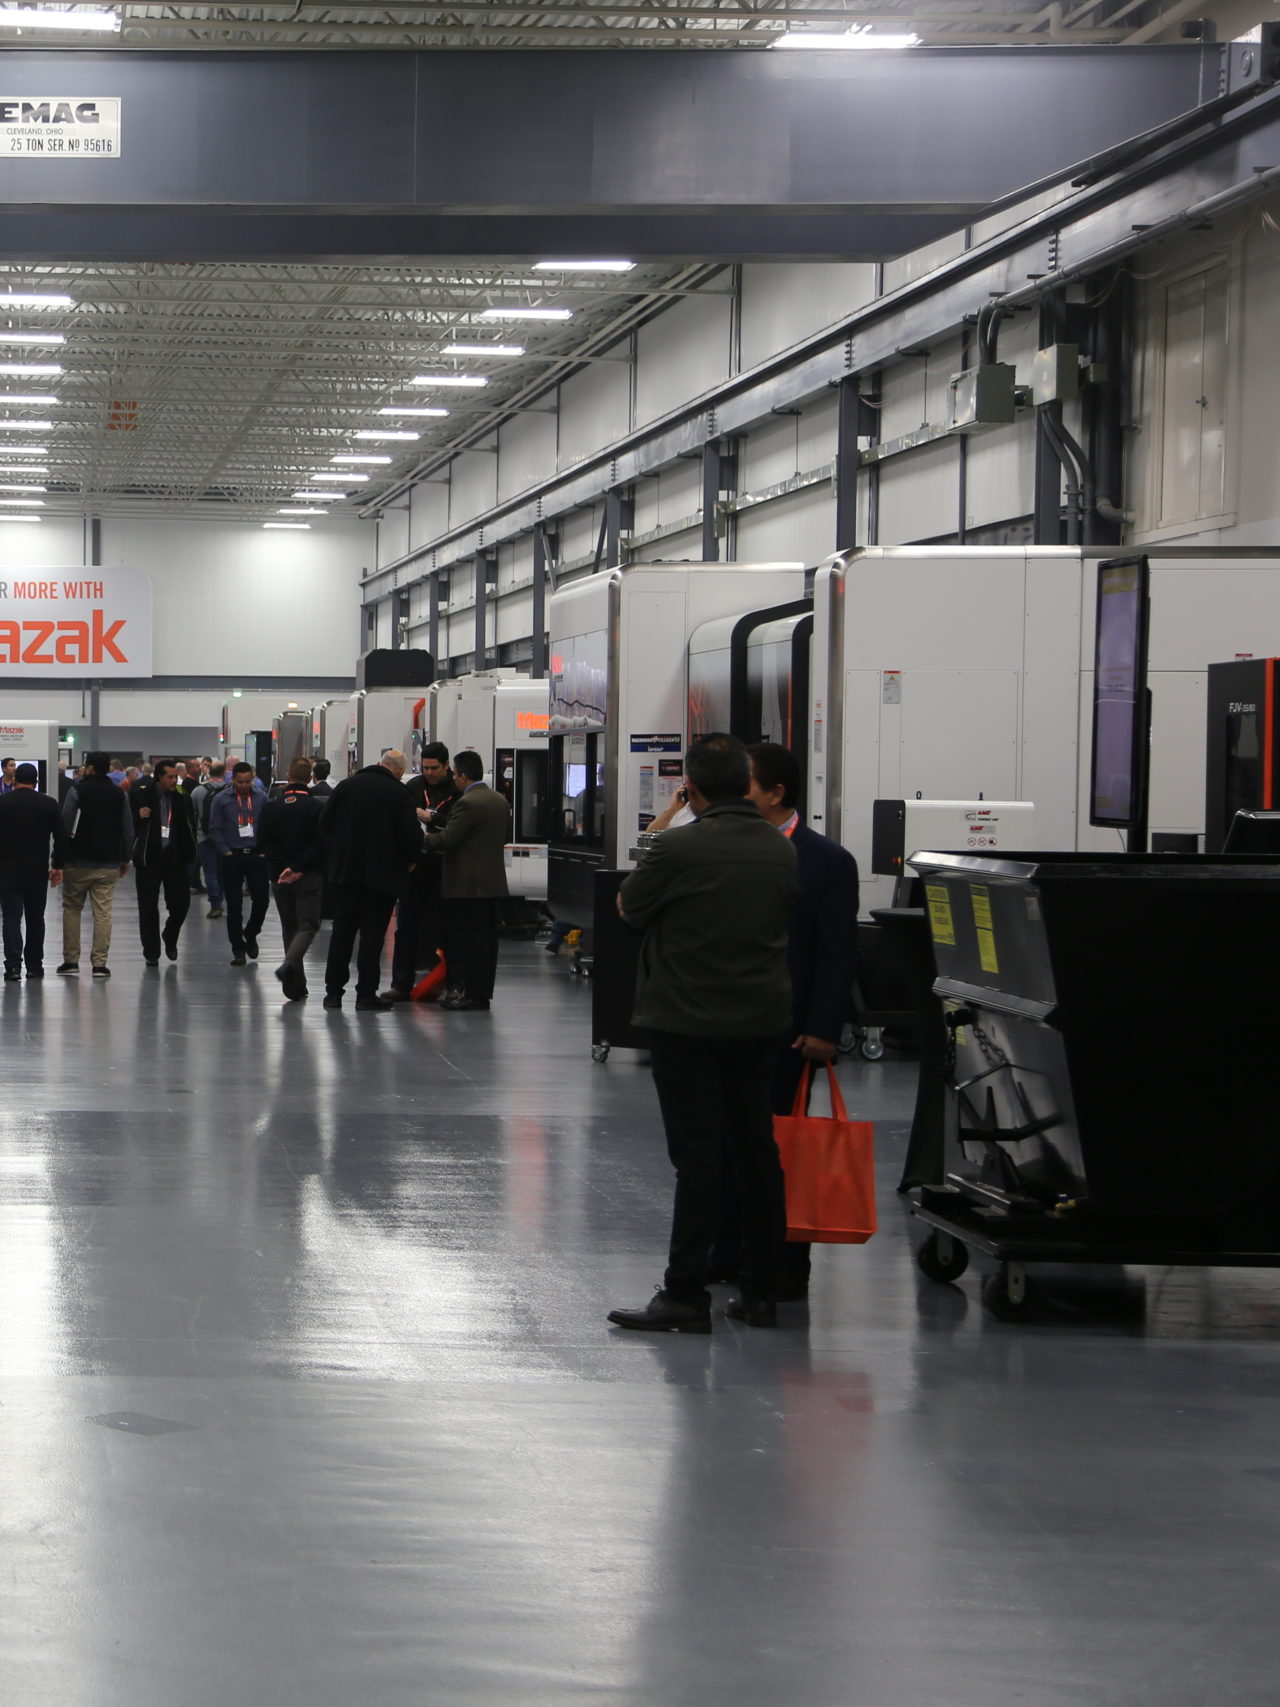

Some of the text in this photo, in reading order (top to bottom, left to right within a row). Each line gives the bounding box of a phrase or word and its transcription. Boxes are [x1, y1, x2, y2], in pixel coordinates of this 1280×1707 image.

[6, 127, 64, 136] CLEVELAND, OHIO
[10, 138, 22, 152] 25
[26, 138, 44, 152] TON
[83, 139, 113, 153] 95616
[13, 581, 59, 600] MORE
[63, 581, 104, 600] WITH
[517, 711, 550, 729] Maz
[0, 726, 25, 734] Mazak
